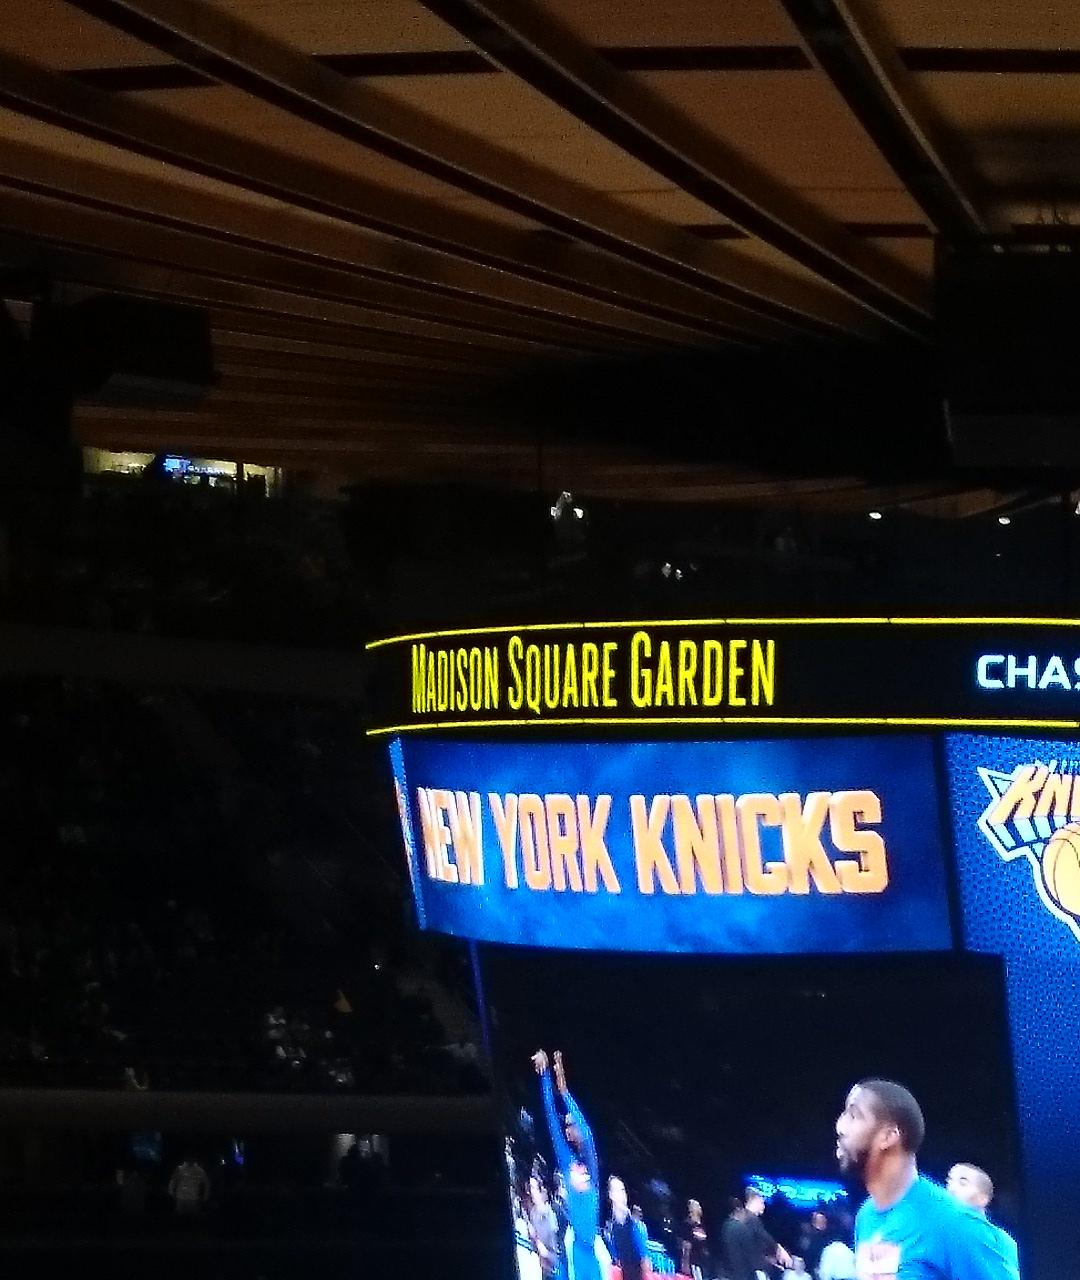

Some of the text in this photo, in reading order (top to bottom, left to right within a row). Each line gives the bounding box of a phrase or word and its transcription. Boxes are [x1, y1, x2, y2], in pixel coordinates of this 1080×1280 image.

[412, 631, 775, 714] MADISON SQUARE GARDEN
[419, 786, 889, 895] NEW YORK KNICKS
